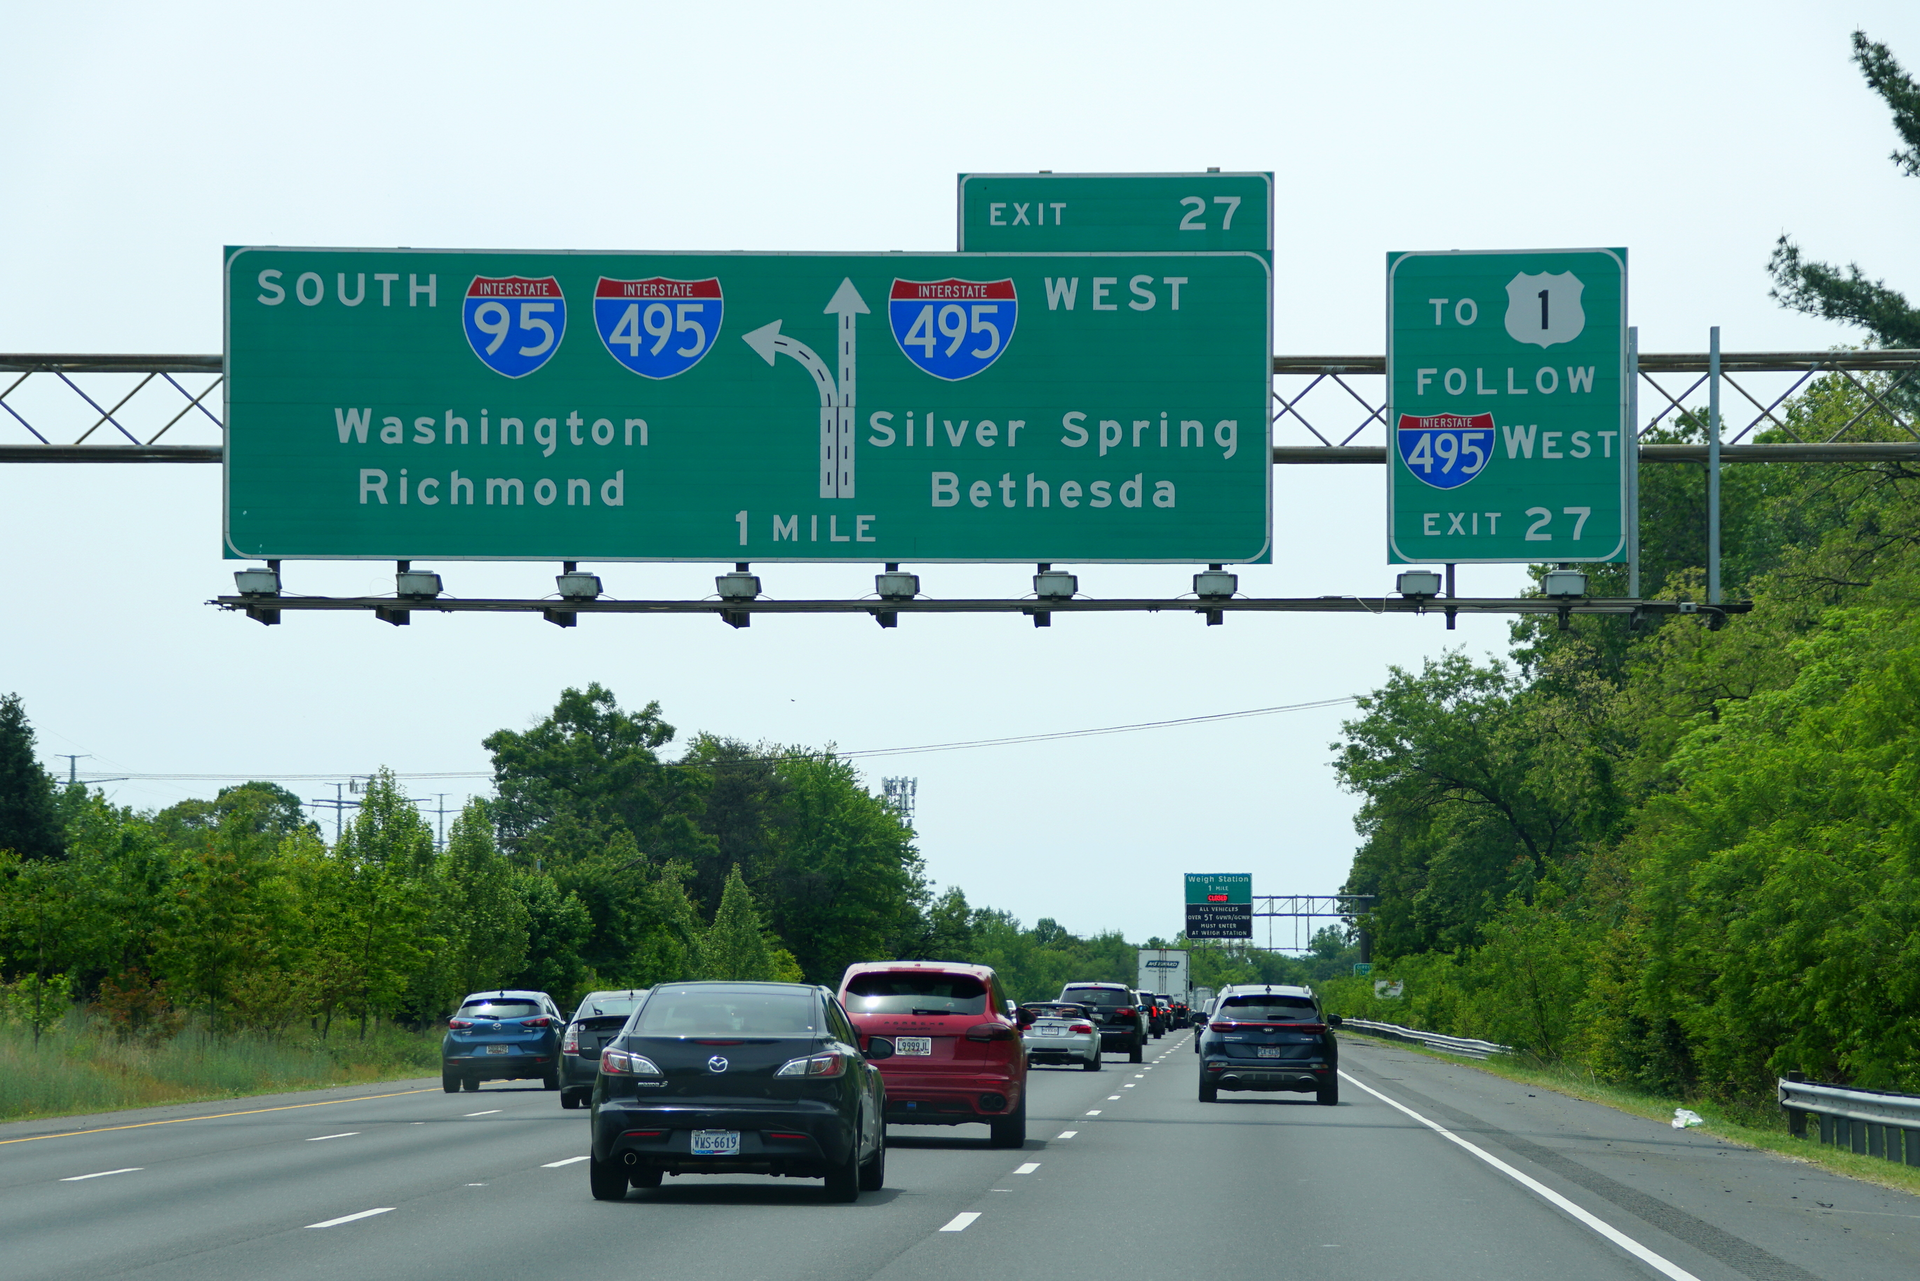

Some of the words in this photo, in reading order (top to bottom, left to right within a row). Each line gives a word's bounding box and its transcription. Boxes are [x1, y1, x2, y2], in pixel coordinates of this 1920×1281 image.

[990, 203, 1066, 225] EXIT
[1179, 196, 1241, 230] 27
[257, 269, 438, 307] SOUTH
[479, 282, 549, 297] INTERSTATE
[623, 283, 693, 297] INTERSTATE
[918, 285, 987, 298] INTERSTATE
[1044, 276, 1188, 311] WEST
[1429, 298, 1478, 326] TO
[1538, 289, 1549, 330] 1
[474, 302, 555, 357] 95
[609, 303, 706, 357] 495
[904, 304, 1000, 359] 495
[1417, 366, 1596, 395] FOLLOW
[334, 406, 649, 458] Washington
[868, 410, 1026, 447] Silver
[1060, 410, 1239, 459] Spring
[1419, 416, 1473, 428] INTERSTATE
[1408, 433, 1484, 474] 495
[1502, 425, 1617, 459] WEST
[359, 468, 624, 506] Richmond
[931, 471, 1176, 508] Bethesda
[735, 510, 748, 546] 1
[773, 514, 876, 543] MILE
[1423, 512, 1502, 536] EXIT
[1525, 507, 1591, 541] 27
[1188, 876, 1214, 884] Weigh
[1204, 913, 1213, 921] 5T
